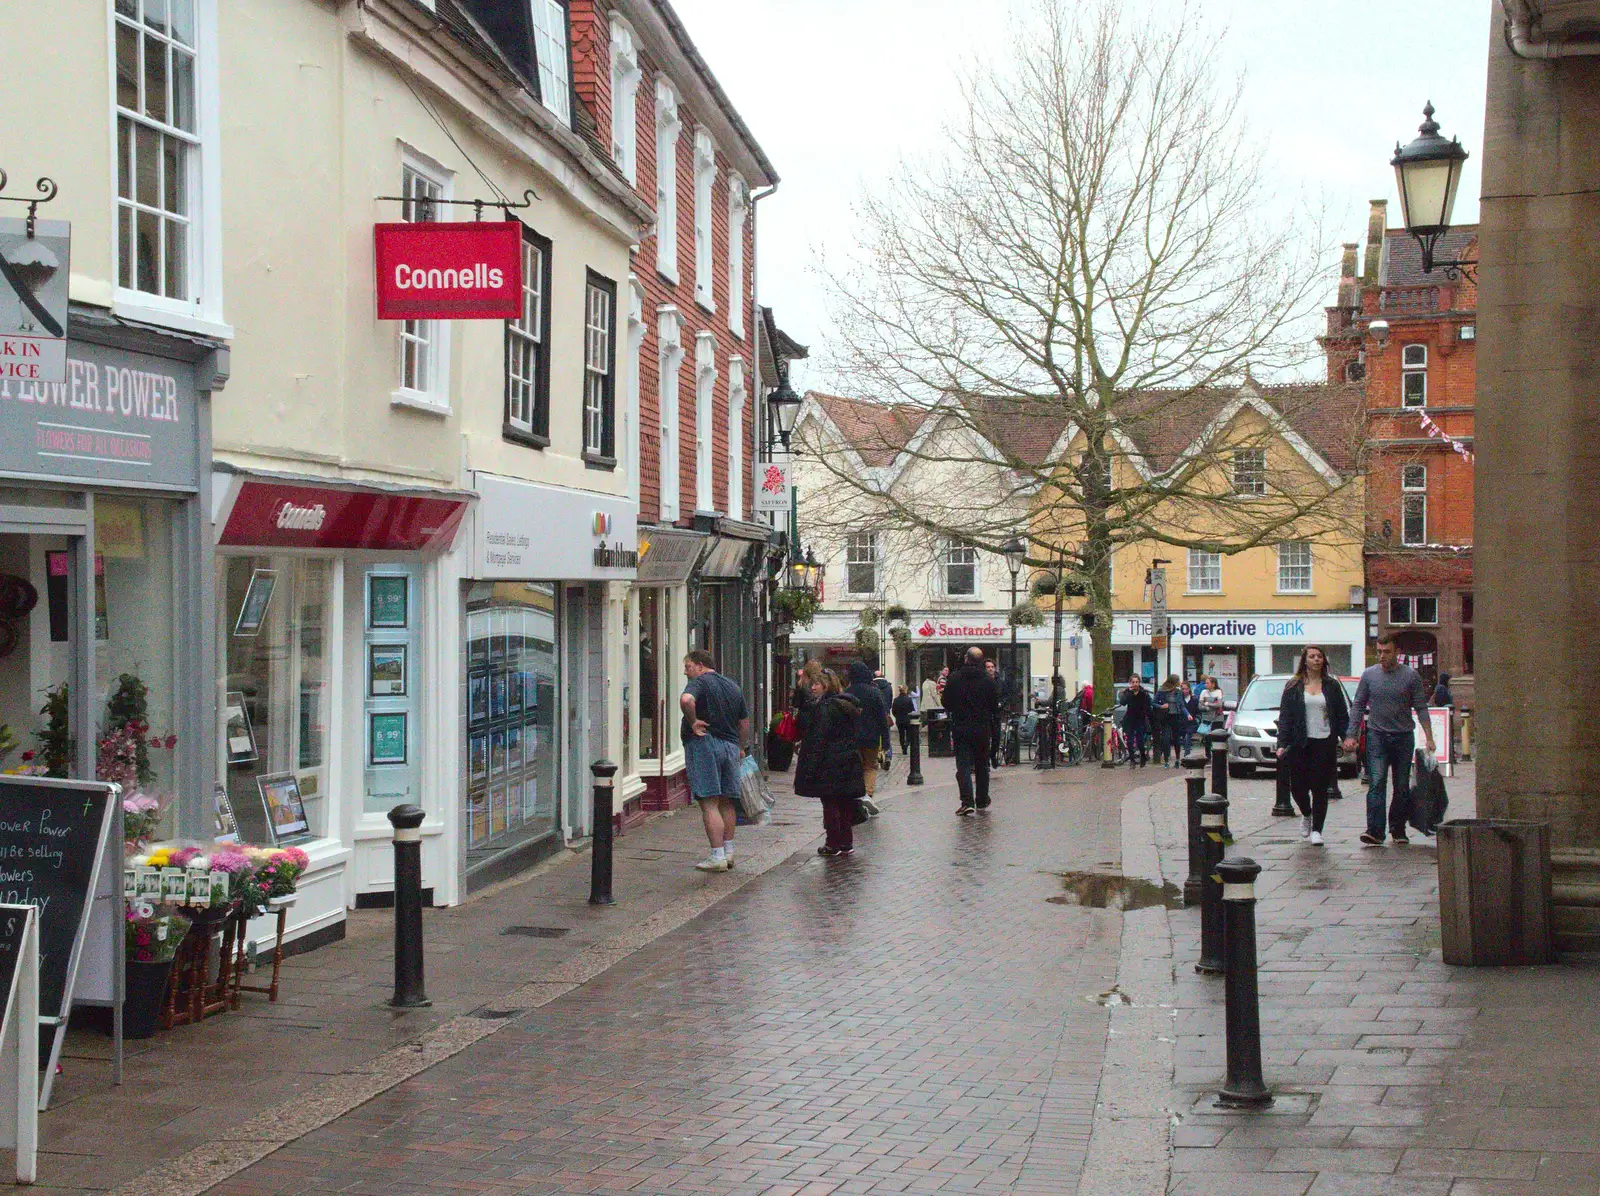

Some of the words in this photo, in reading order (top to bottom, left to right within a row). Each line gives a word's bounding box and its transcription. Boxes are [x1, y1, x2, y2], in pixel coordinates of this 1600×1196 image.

[394, 263, 504, 290] Connells
[21, 342, 41, 357] IN
[0, 362, 40, 379] VICE
[105, 365, 179, 422] POWER
[939, 622, 1004, 637] Santander
[1127, 619, 1152, 636] The
[1171, 619, 1257, 639] -operative
[1266, 619, 1305, 636] bank
